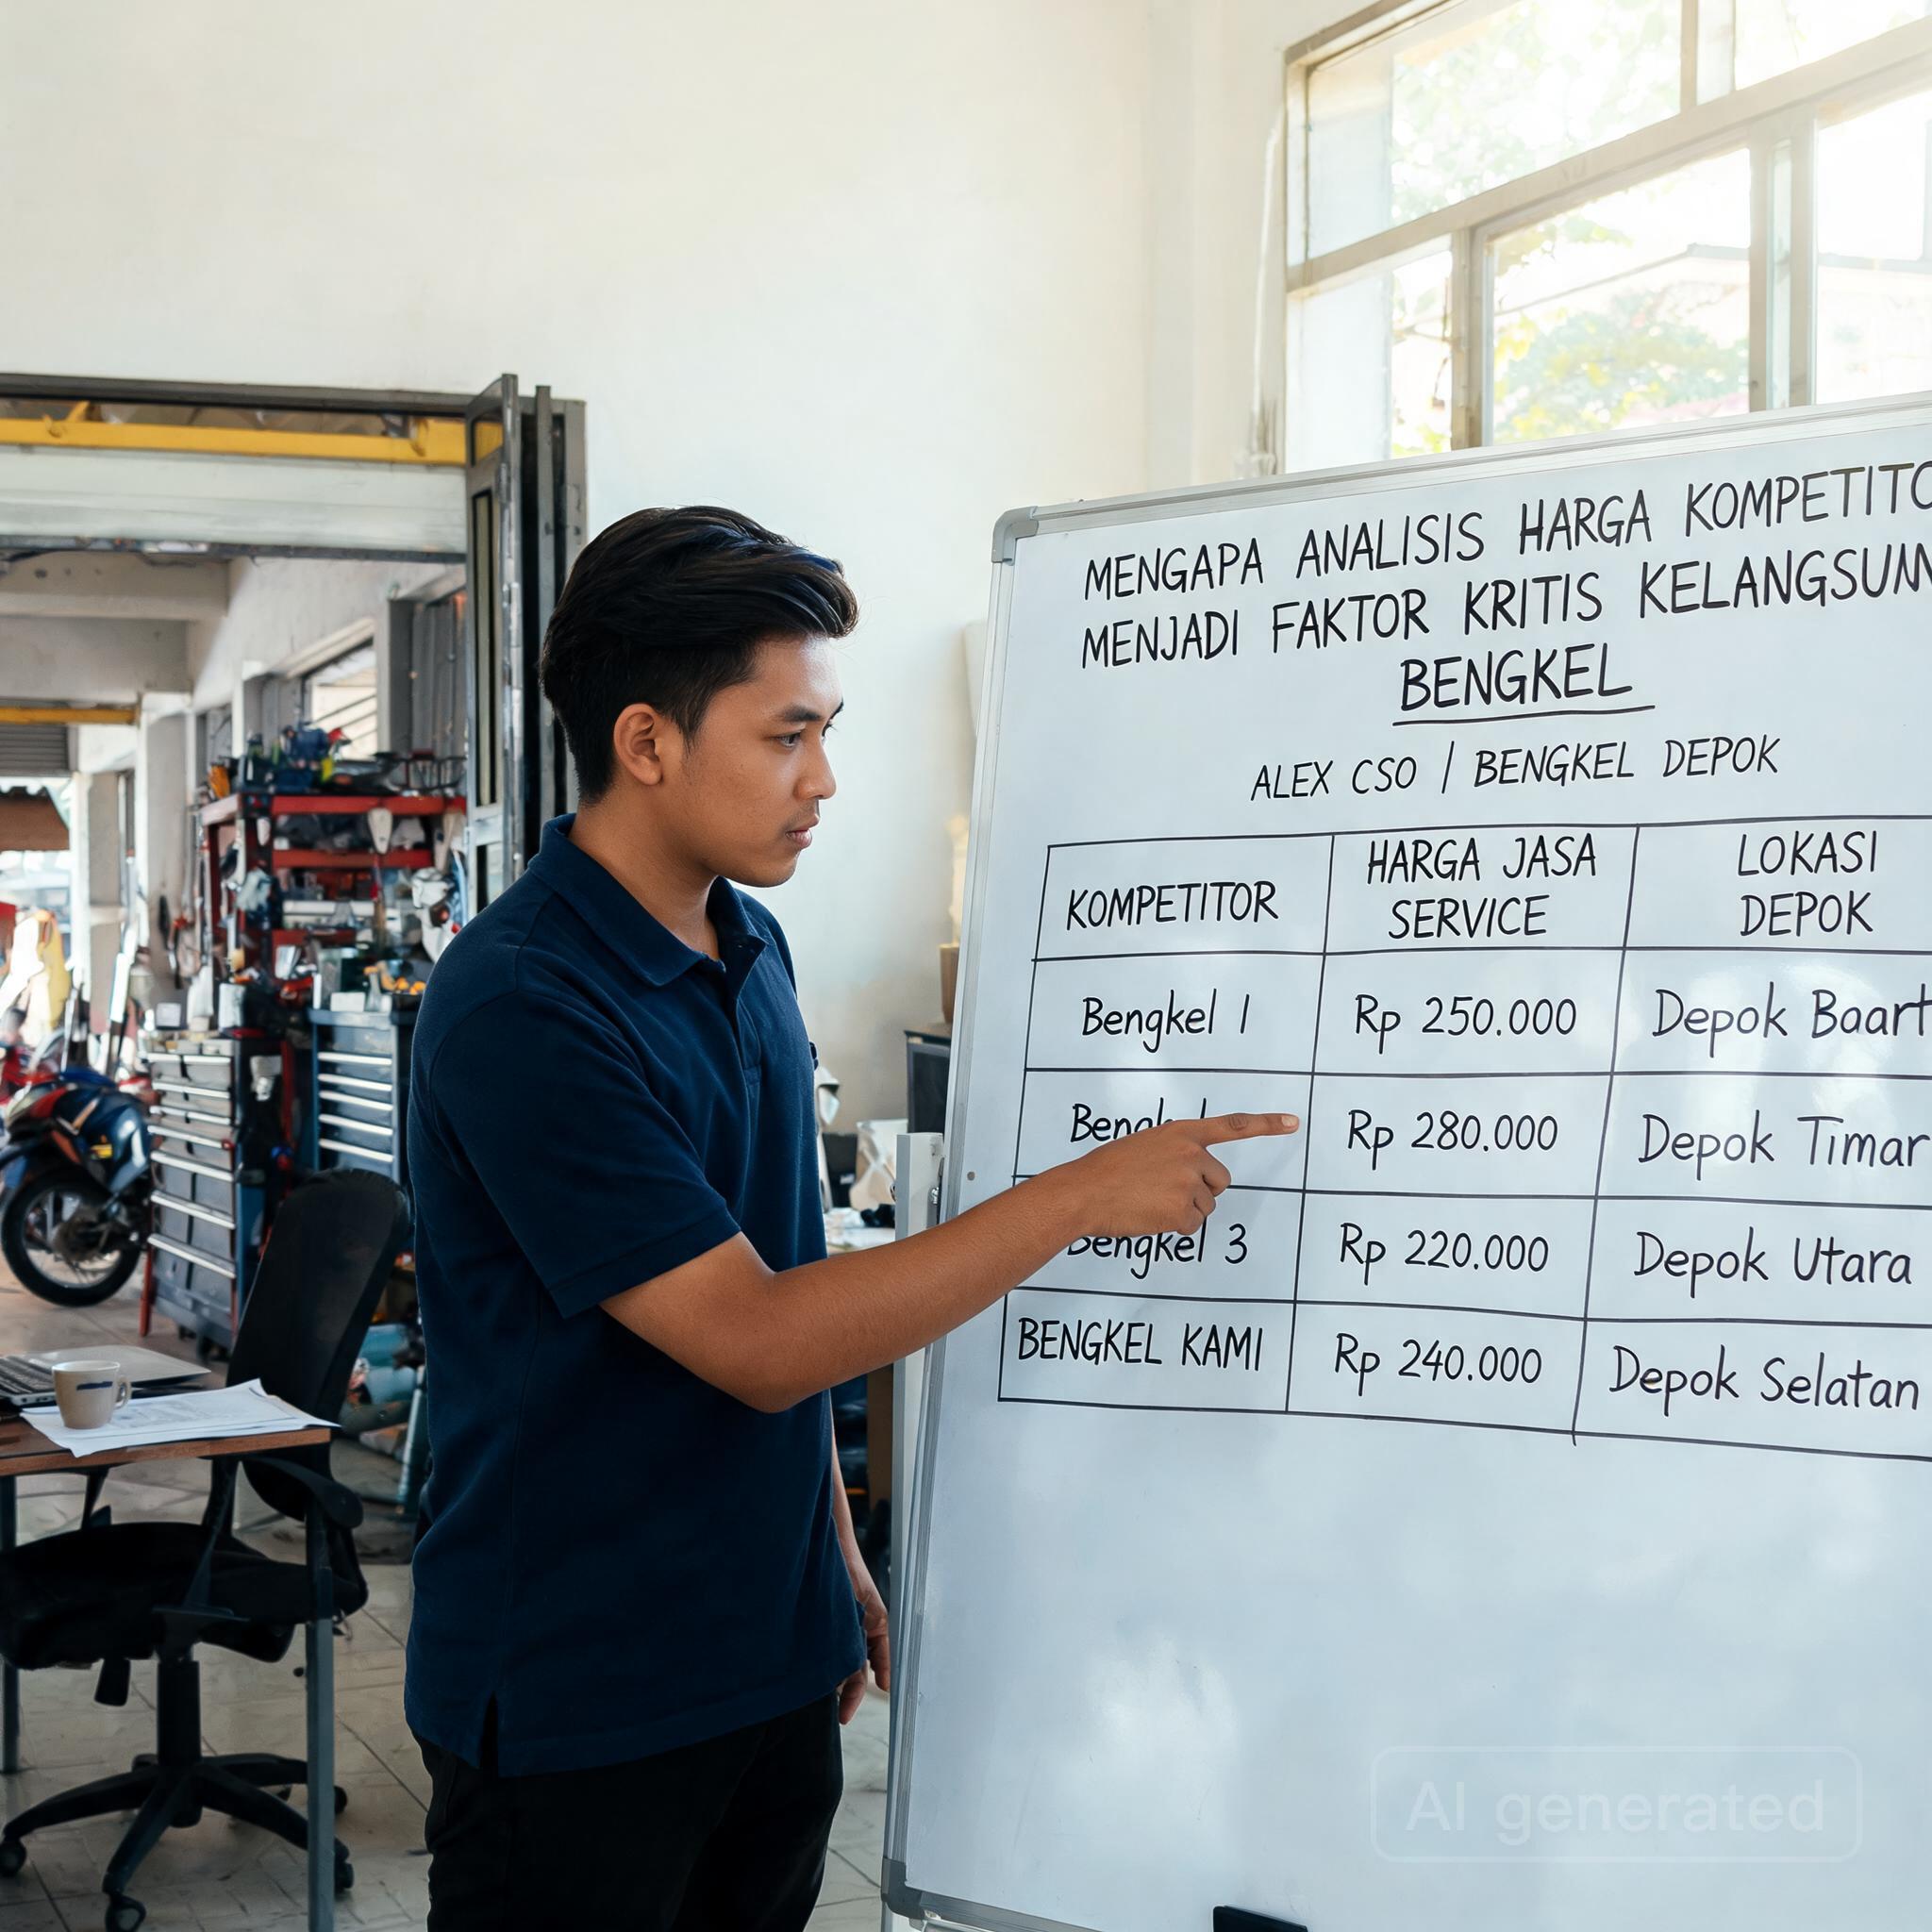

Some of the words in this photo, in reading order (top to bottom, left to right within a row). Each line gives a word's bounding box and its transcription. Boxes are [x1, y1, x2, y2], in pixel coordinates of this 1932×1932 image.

[1085, 538, 1263, 600] MENGAPA
[1296, 512, 1484, 578] ANALISIS
[1520, 483, 1652, 555] HARGA
[1082, 609, 1239, 669] MENJADI
[1273, 589, 1429, 654] FAKTOR
[1464, 561, 1602, 630] KRITIS
[1400, 642, 1633, 712] BENGKEL
[1251, 759, 1333, 802] ALEX
[1352, 756, 1416, 794] CSO
[1474, 741, 1634, 787] BENGKEL
[1663, 734, 1780, 777] DEPOK
[1368, 833, 1480, 884] HARGA
[1503, 831, 1596, 878] JASA
[1738, 830, 1877, 876] LOKASI
[1067, 881, 1278, 930] KOMPETITOR
[1389, 894, 1550, 939] SERVICE
[1740, 891, 1874, 937] DEPOK
[1081, 989, 1217, 1054] Bengkel
[1355, 994, 1402, 1055] Rp
[1421, 996, 1577, 1037] 250.000
[1652, 981, 1789, 1058] Depok
[1348, 1109, 1394, 1171] Rp
[1411, 1110, 1558, 1152] 280.000
[1638, 1109, 1774, 1181] Depok
[1796, 1115, 1931, 1168] Timar
[1224, 1224, 1248, 1264] 3
[1341, 1223, 1386, 1286] Rp
[1405, 1229, 1549, 1273] 220.000
[1634, 1226, 1770, 1299] Depok
[1793, 1237, 1912, 1285] Utara
[1018, 1317, 1163, 1366] BENGKEL
[1181, 1323, 1263, 1372] KAMI
[1335, 1333, 1381, 1396] Rp
[1398, 1340, 1542, 1384] 240.000
[1609, 1344, 1740, 1417] Depok
[1760, 1352, 1920, 1411] Selatan
